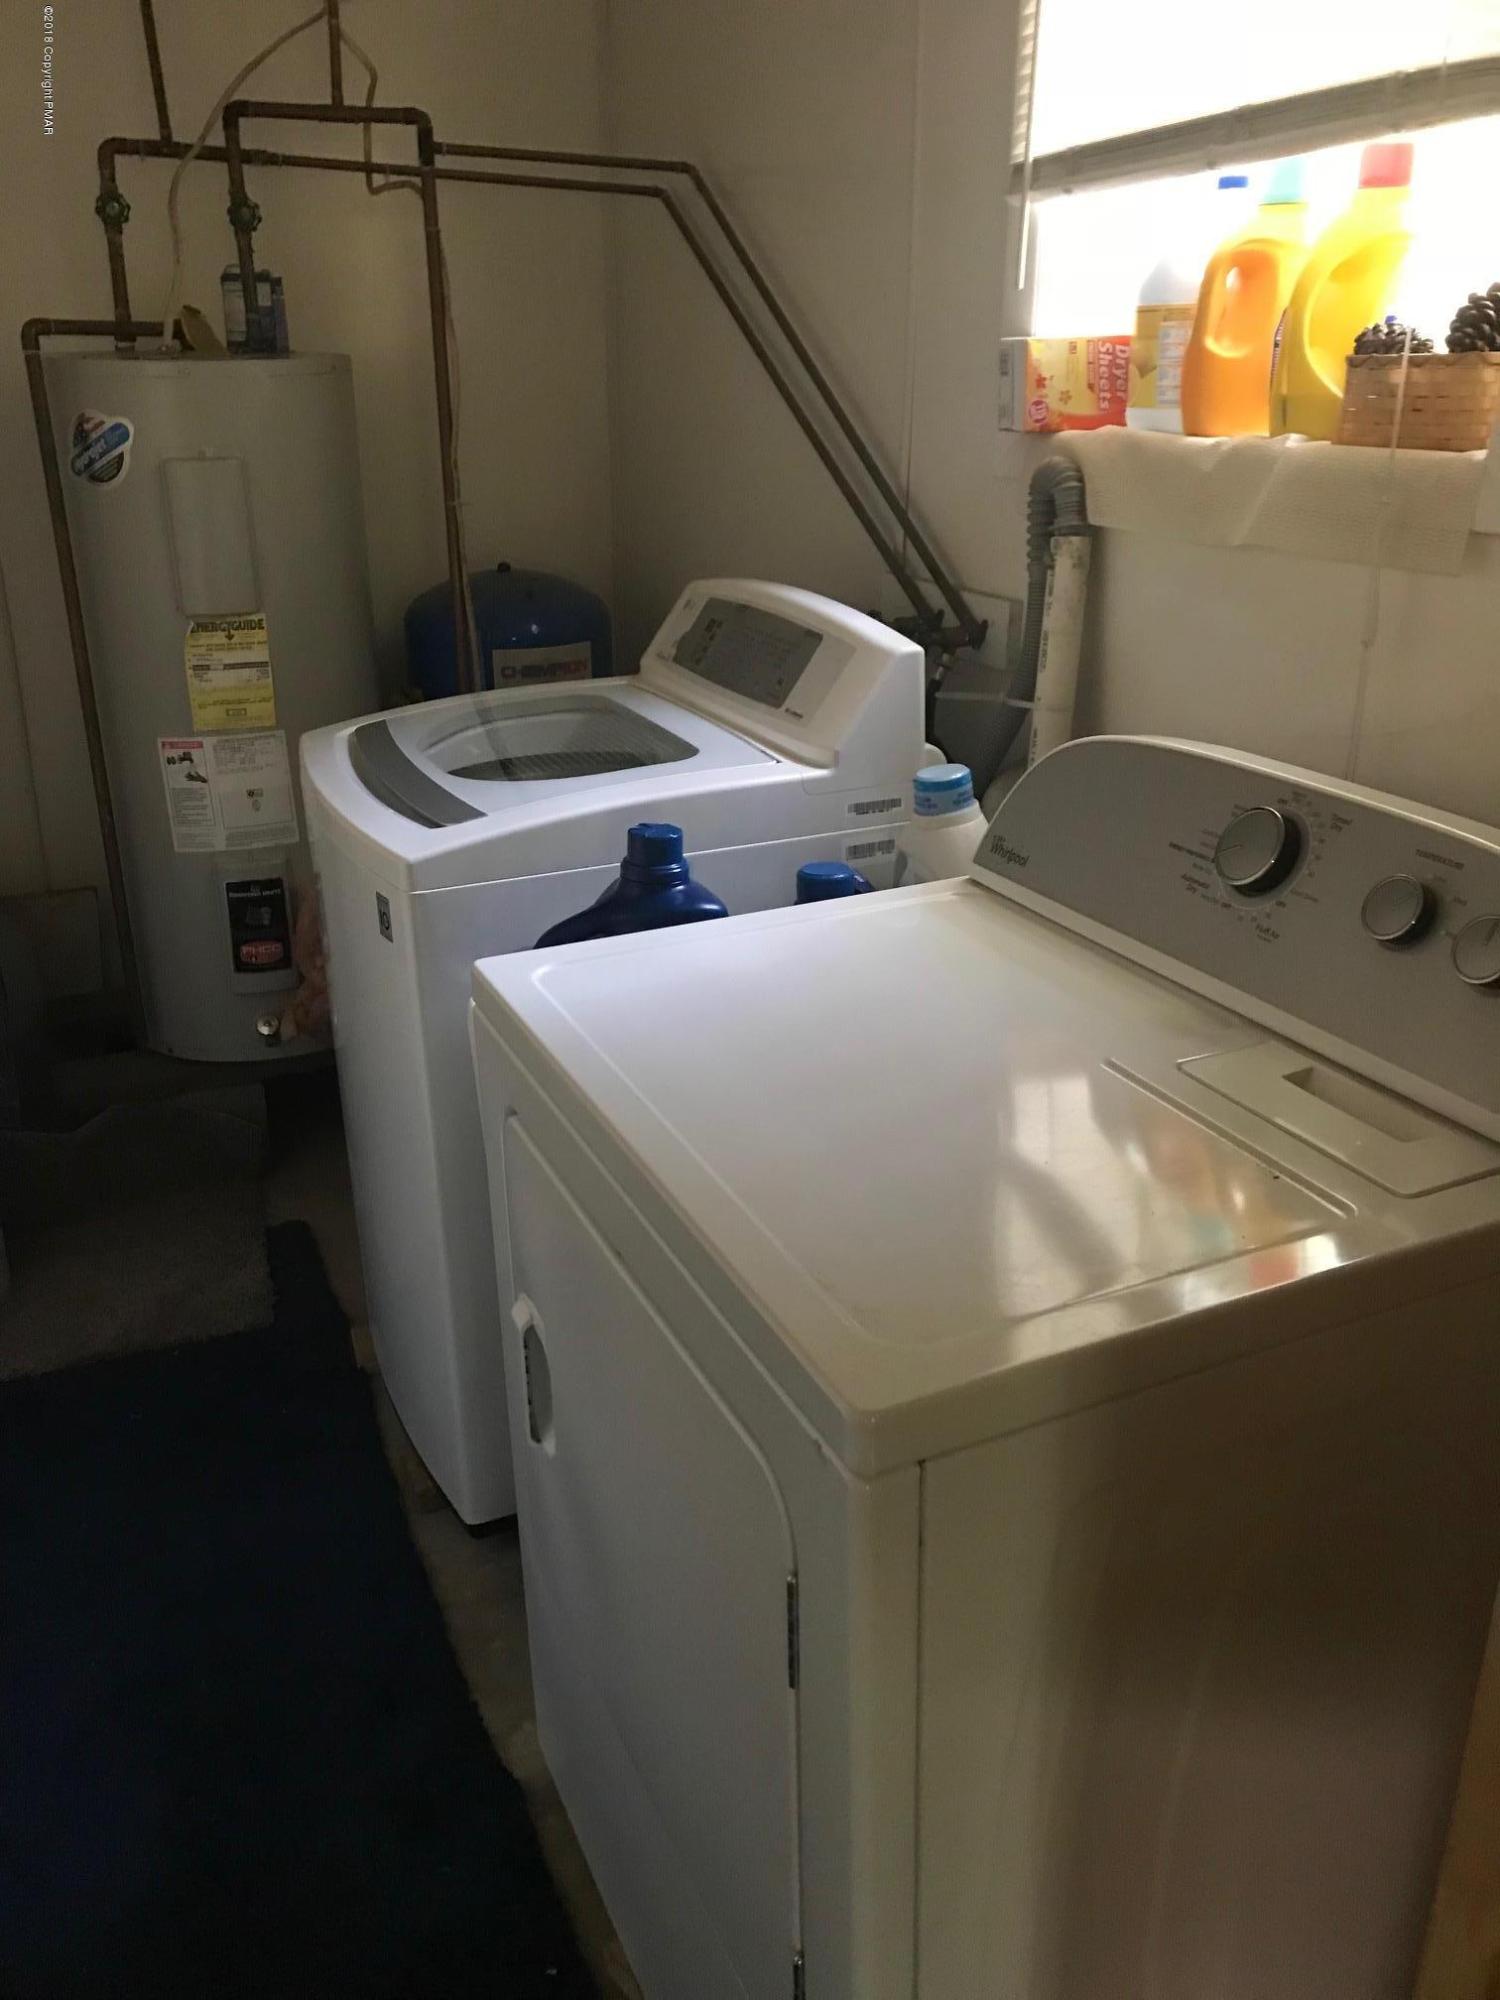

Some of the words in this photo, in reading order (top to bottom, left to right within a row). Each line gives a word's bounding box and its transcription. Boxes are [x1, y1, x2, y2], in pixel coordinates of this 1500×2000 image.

[1097, 341, 1113, 410] Sheets
[1112, 341, 1131, 401] Dryer
[988, 840, 1029, 868] Whirlpool
